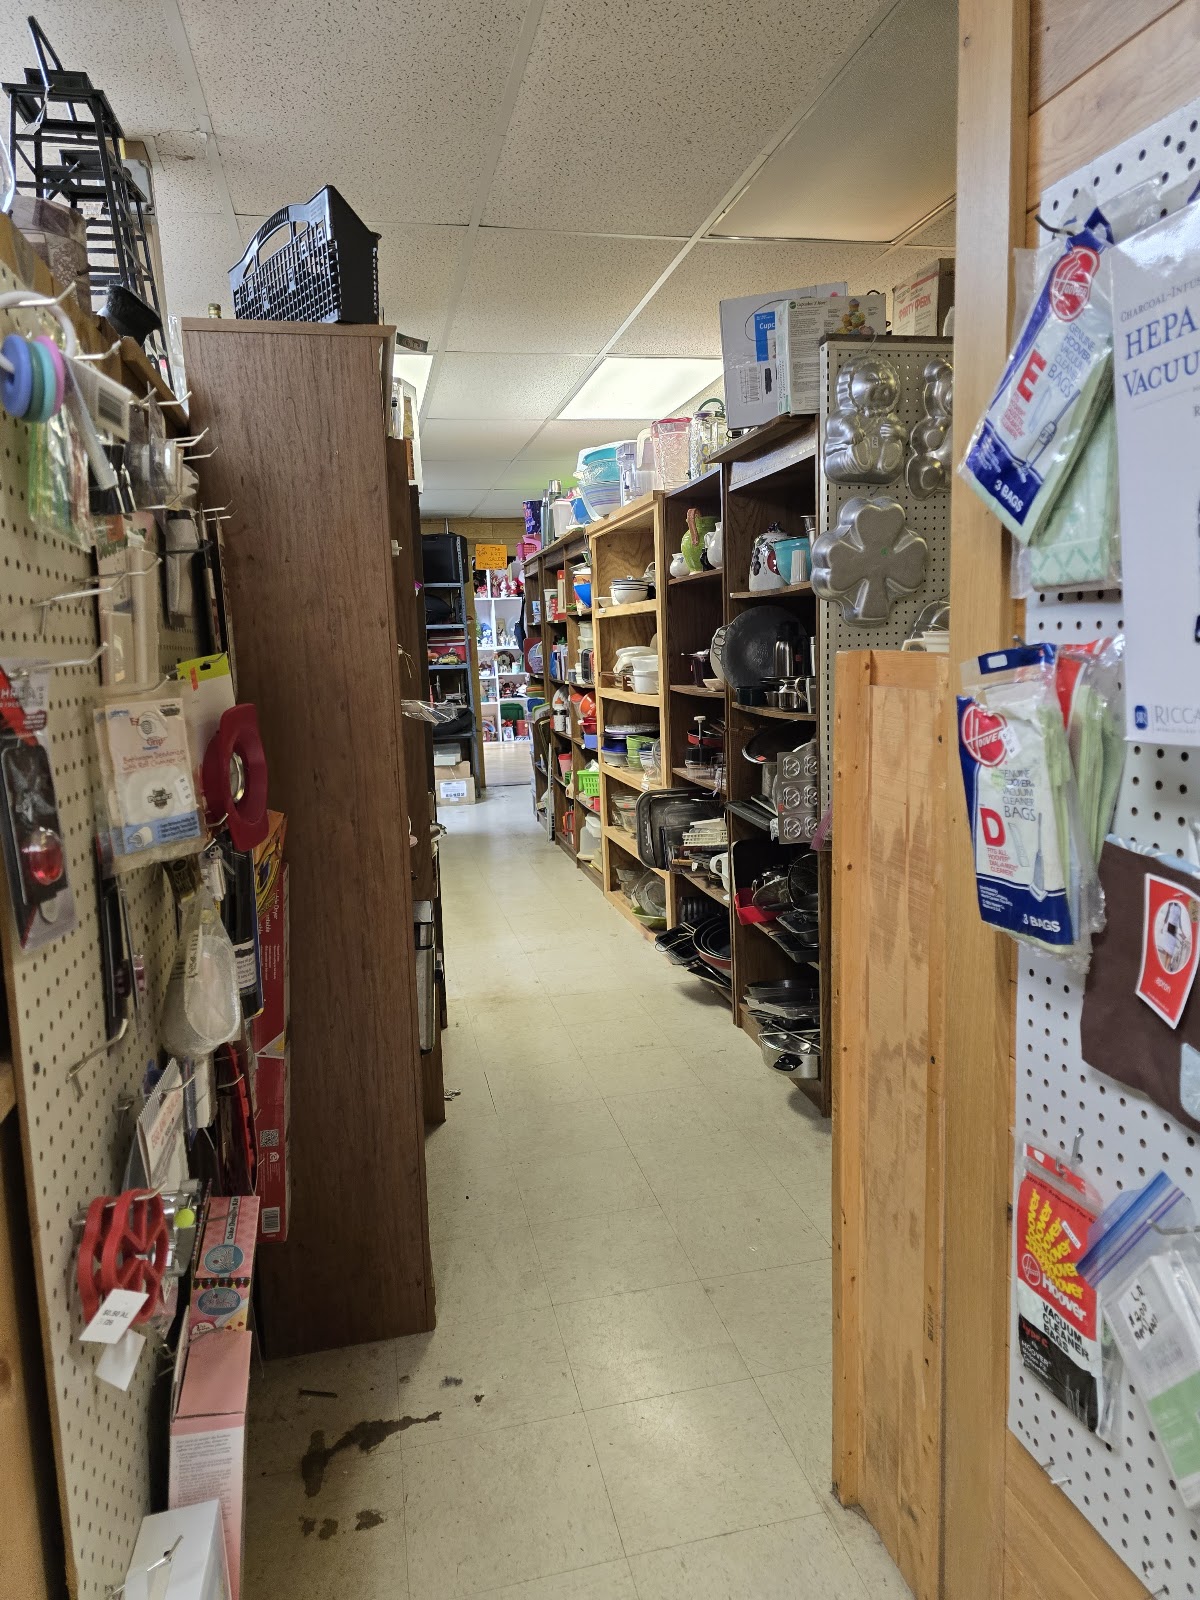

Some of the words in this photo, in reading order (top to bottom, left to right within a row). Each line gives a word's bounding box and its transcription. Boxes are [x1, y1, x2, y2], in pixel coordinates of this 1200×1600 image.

[1125, 305, 1199, 361] HEPA
[1016, 349, 1047, 403] E
[1048, 364, 1074, 399] BAGS
[994, 480, 1002, 491] 3
[1001, 485, 1024, 512] BAGS
[980, 807, 1006, 848] D
[1004, 805, 1036, 822] BAGS
[1023, 913, 1029, 925] 3
[1029, 915, 1061, 933] BAGS
[1155, 976, 1172, 994] apron
[1042, 1274, 1087, 1322] Hoover
[1042, 1301, 1082, 1346] VACUUM
[1042, 1312, 1089, 1361] CLEANER
[1043, 1323, 1069, 1354] BAGS
[1022, 1339, 1050, 1368] HOOVER
[1043, 1337, 1049, 1348] C
